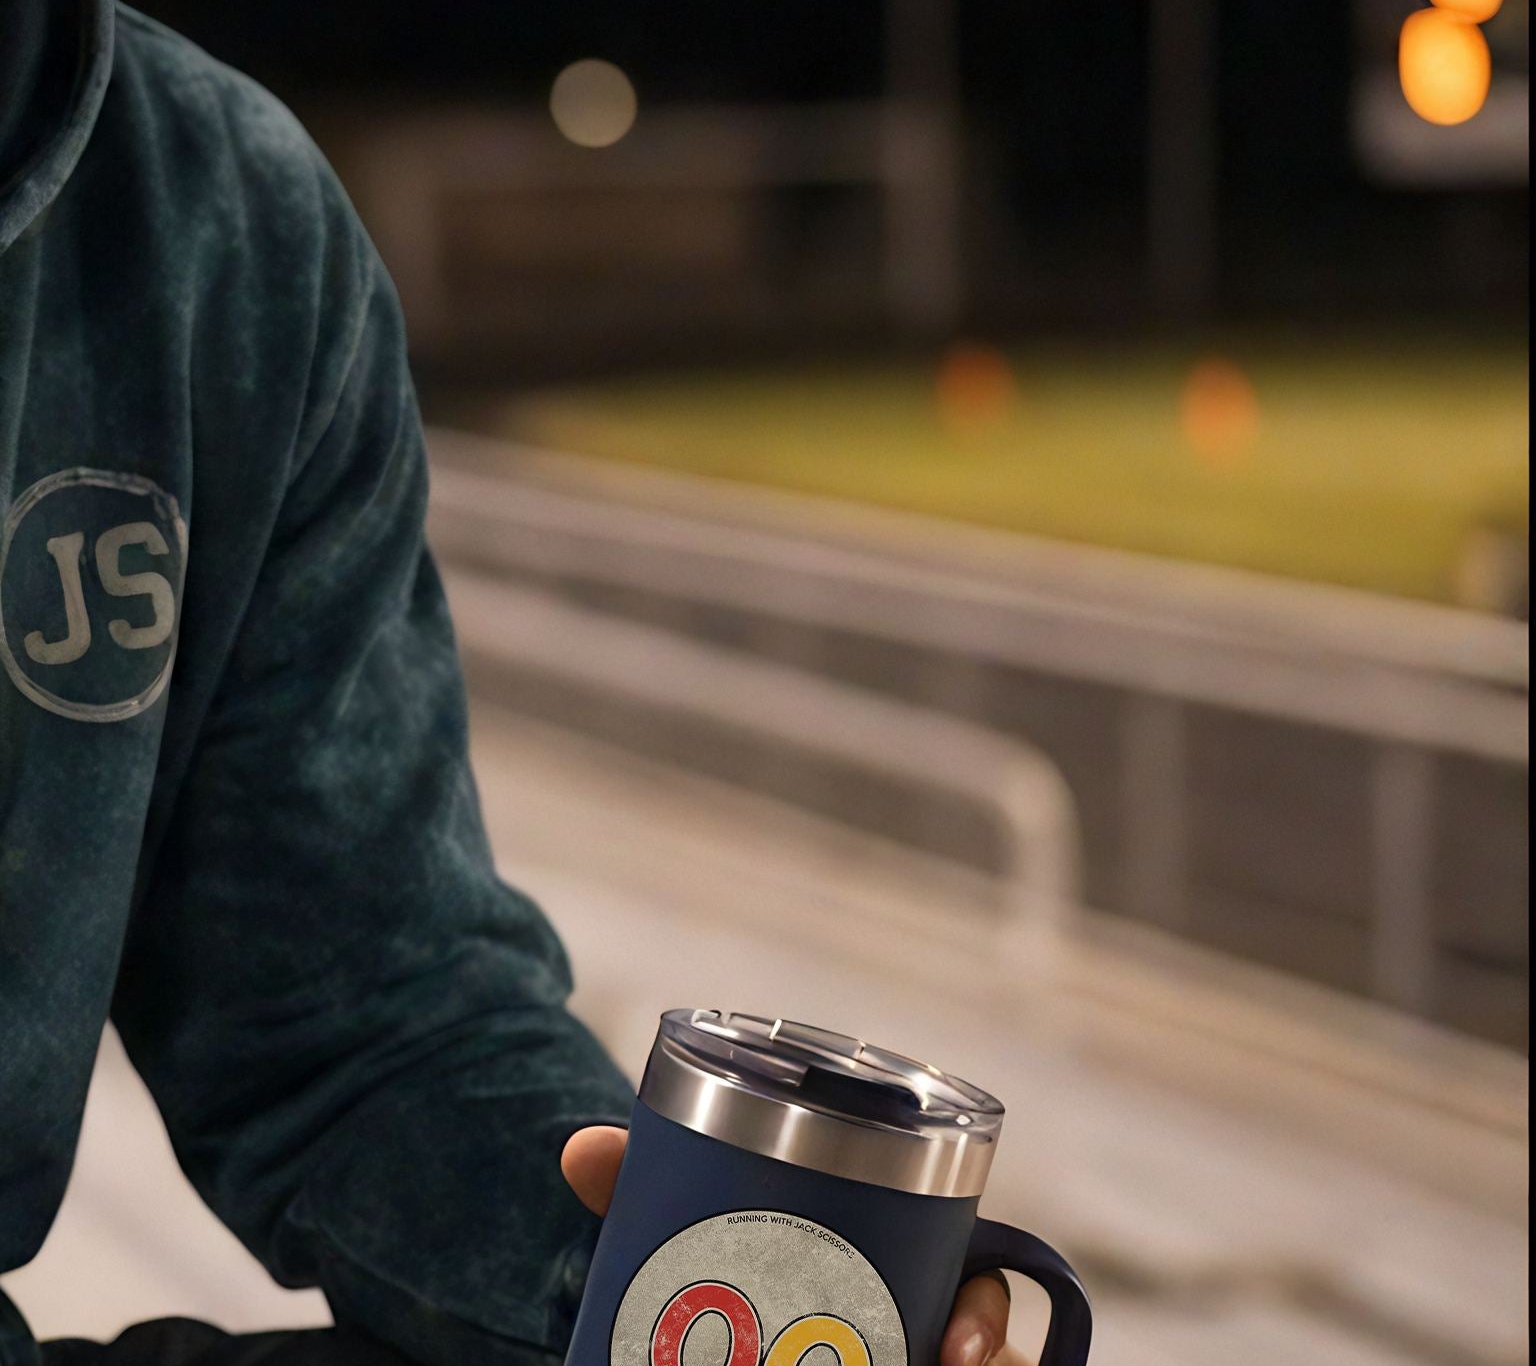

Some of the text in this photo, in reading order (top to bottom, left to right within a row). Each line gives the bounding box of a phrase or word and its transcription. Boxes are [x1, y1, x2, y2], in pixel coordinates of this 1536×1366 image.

[24, 521, 175, 665] JS
[727, 1214, 855, 1259] RUNNING WITH JACK SCISSORS
